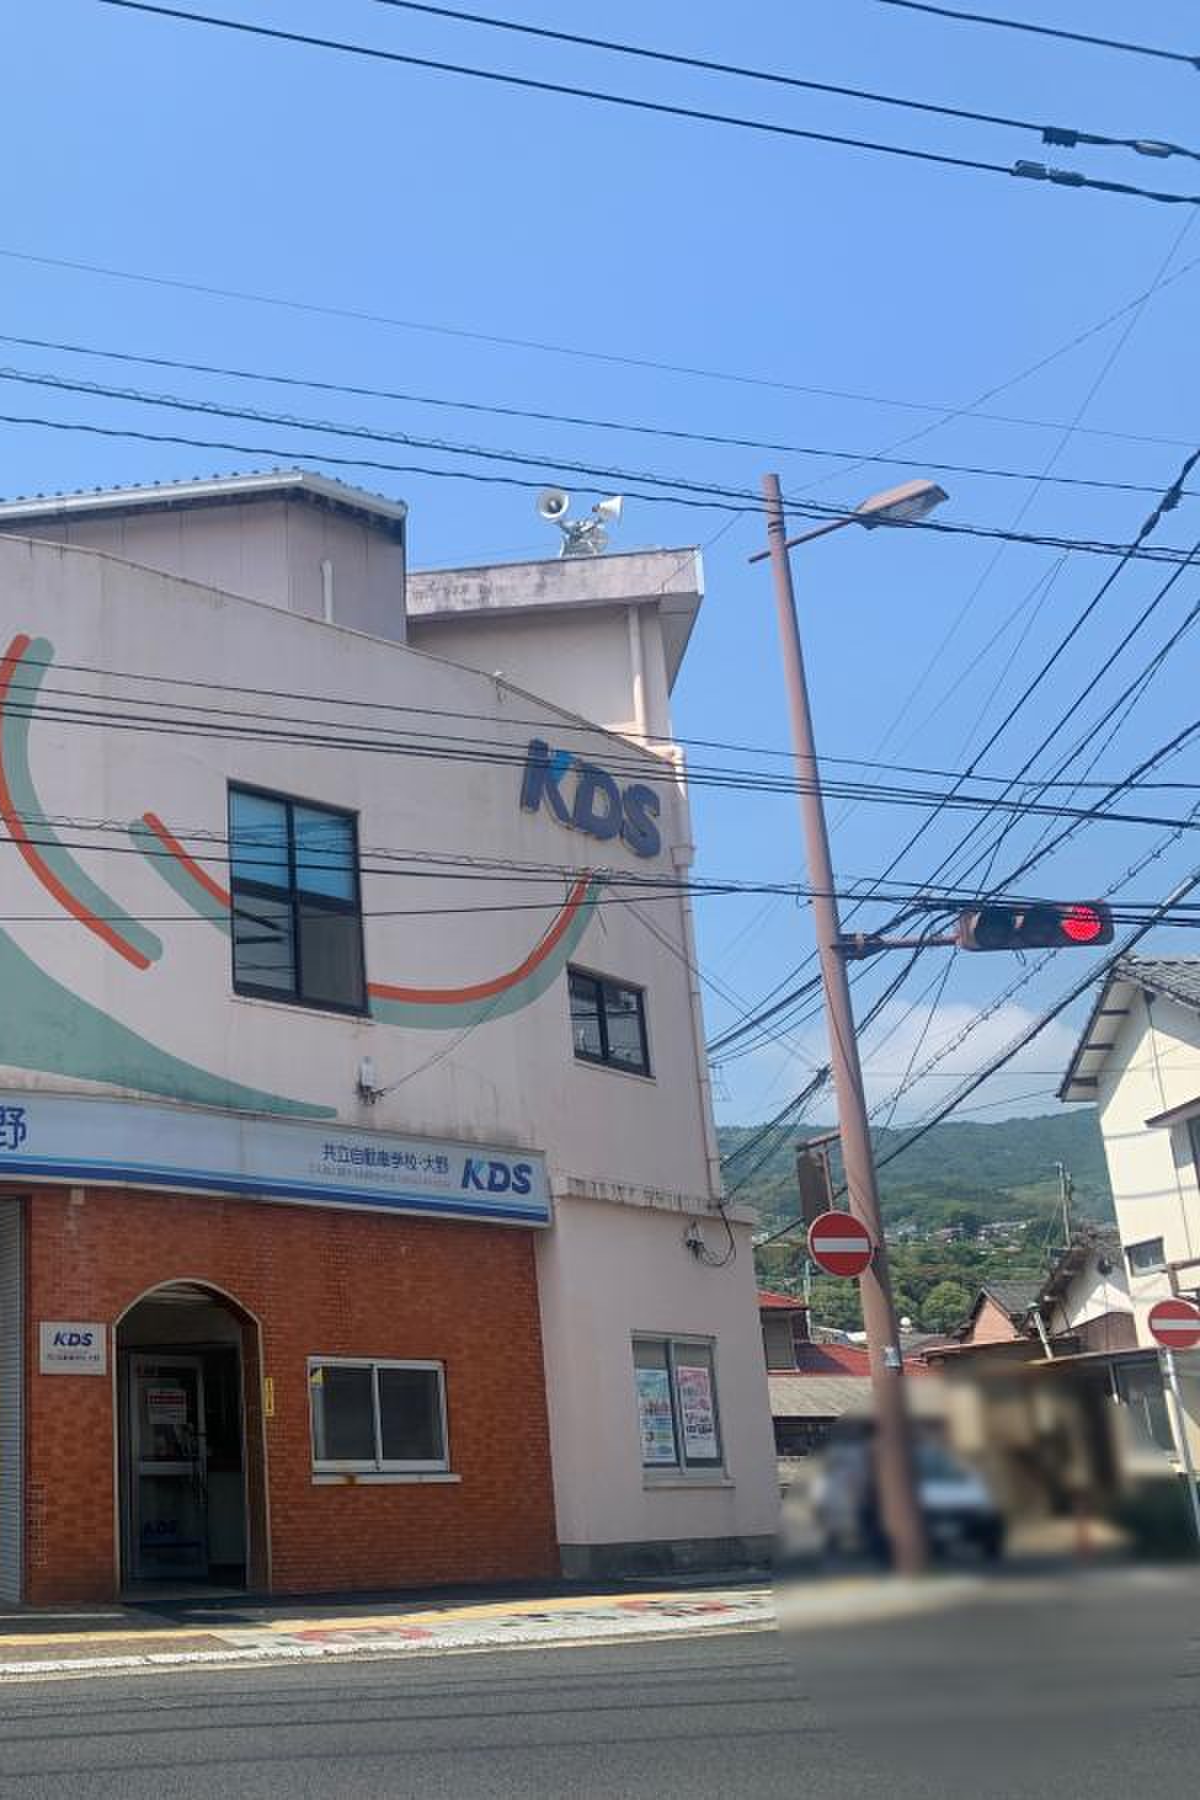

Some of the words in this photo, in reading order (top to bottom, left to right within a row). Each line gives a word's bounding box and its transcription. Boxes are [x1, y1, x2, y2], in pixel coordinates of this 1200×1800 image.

[520, 738, 661, 859] KDS
[461, 1158, 532, 1195] KDS
[53, 1331, 93, 1346] KDS
